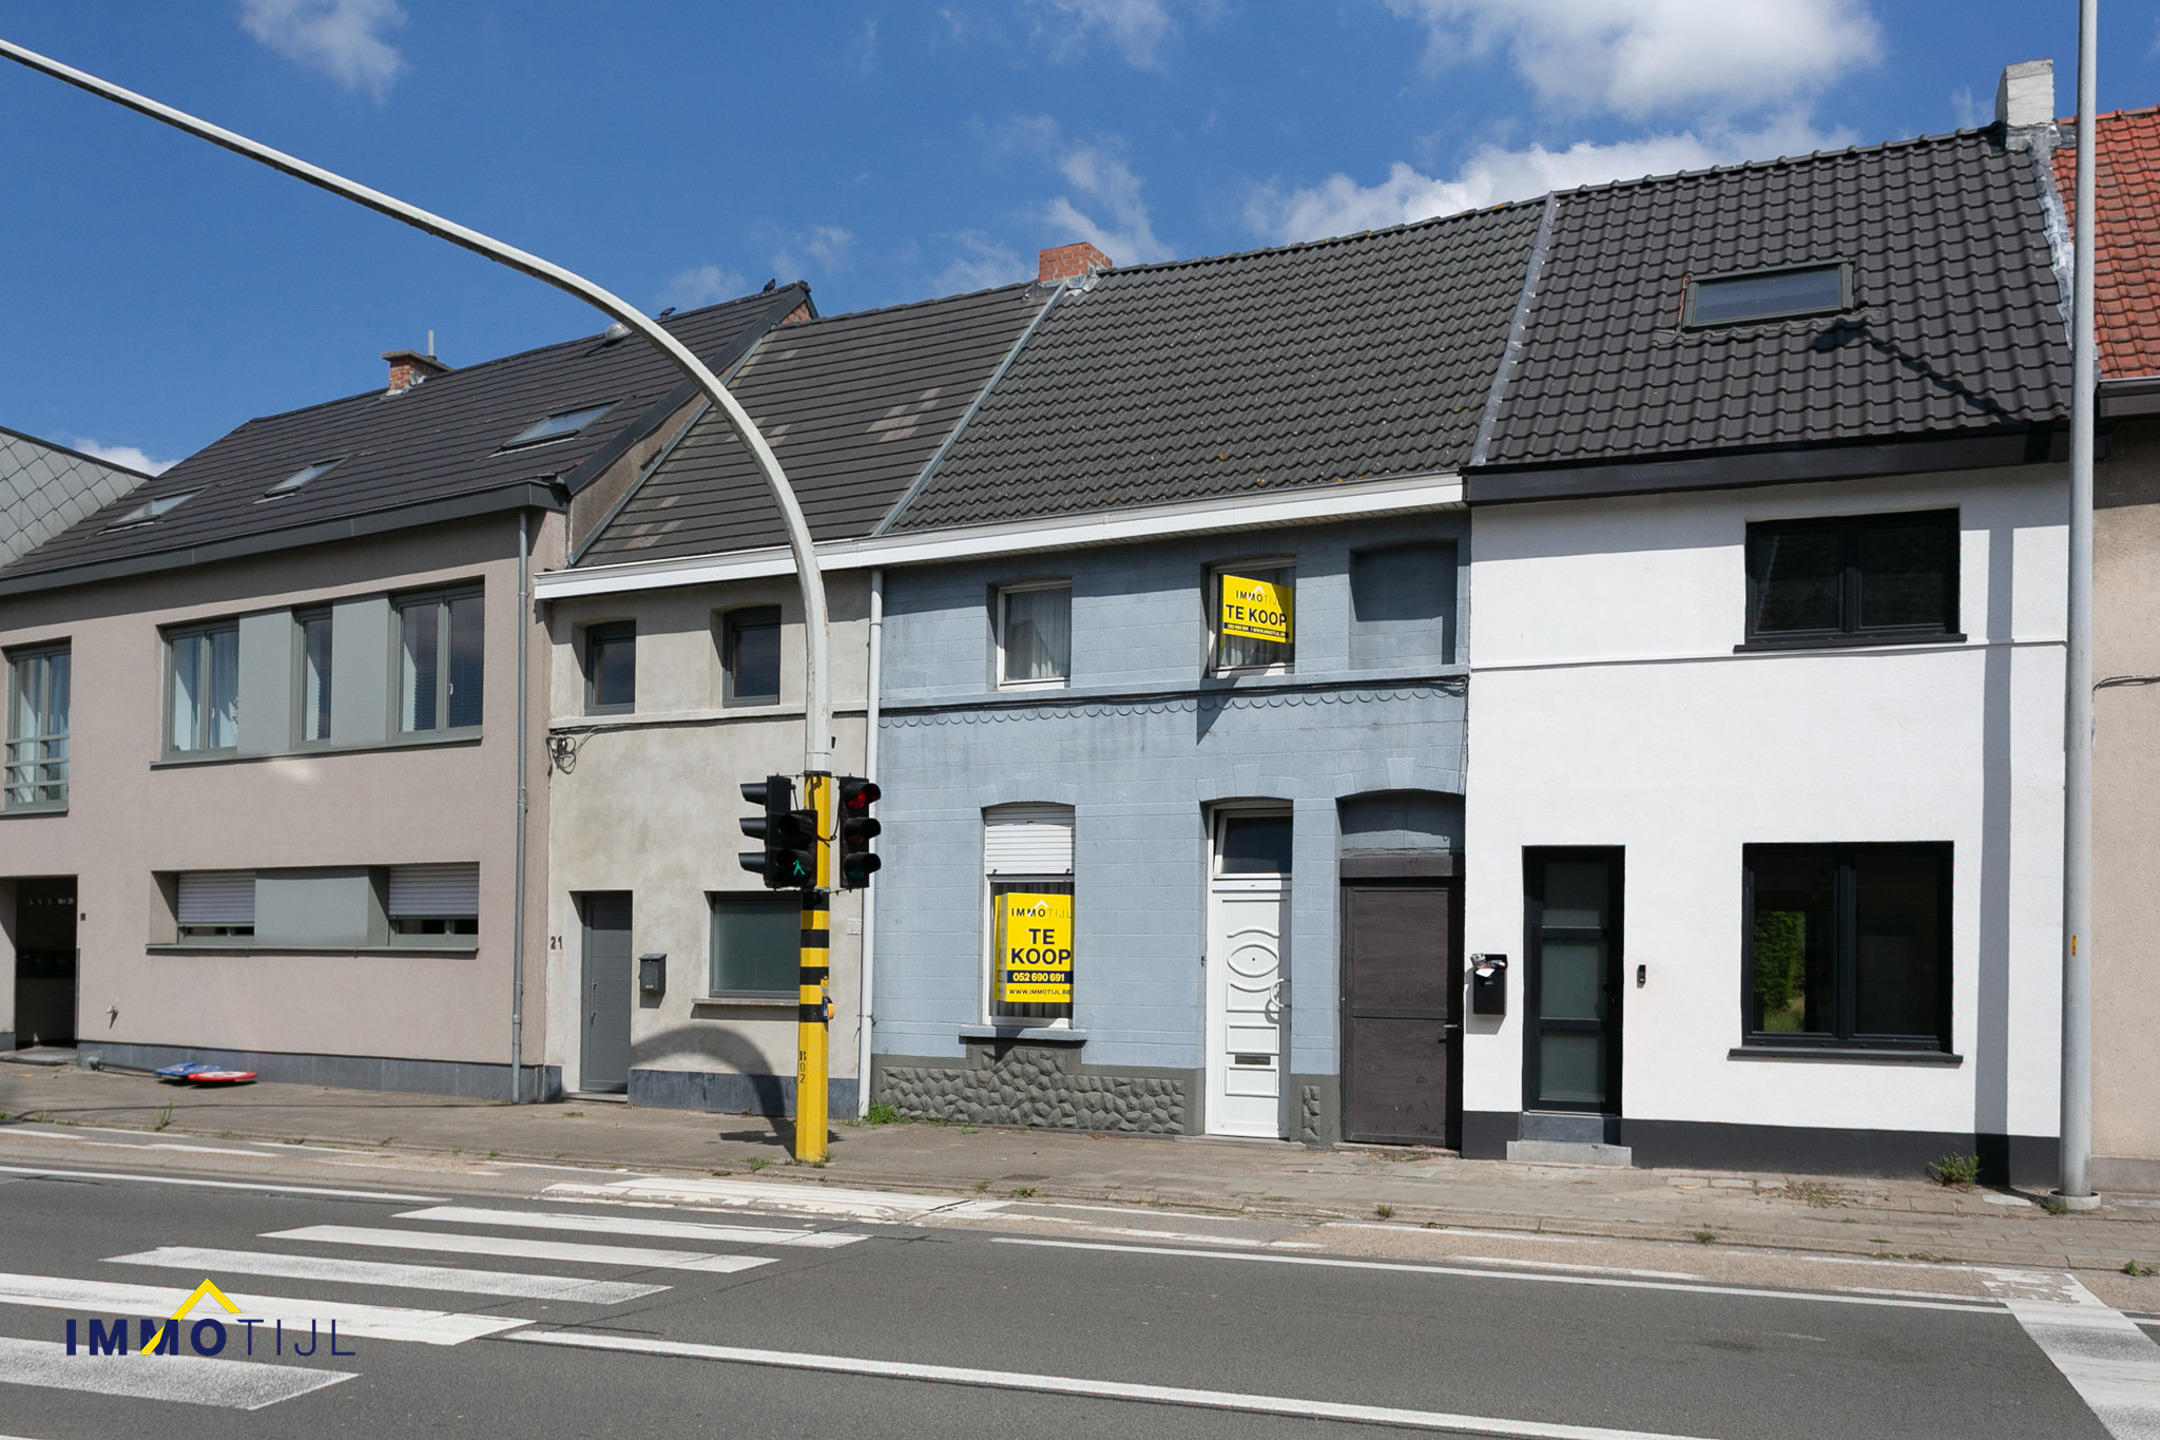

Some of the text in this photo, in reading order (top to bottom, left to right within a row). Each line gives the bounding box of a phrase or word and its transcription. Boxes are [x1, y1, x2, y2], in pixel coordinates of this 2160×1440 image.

[1225, 604, 1287, 626] TE KOOP
[1011, 908, 1072, 918] IMMOTIJL
[551, 936, 562, 949] 21
[1028, 928, 1055, 945] TE
[1011, 948, 1071, 965] KOOP
[1012, 972, 1065, 982] 052 690 691
